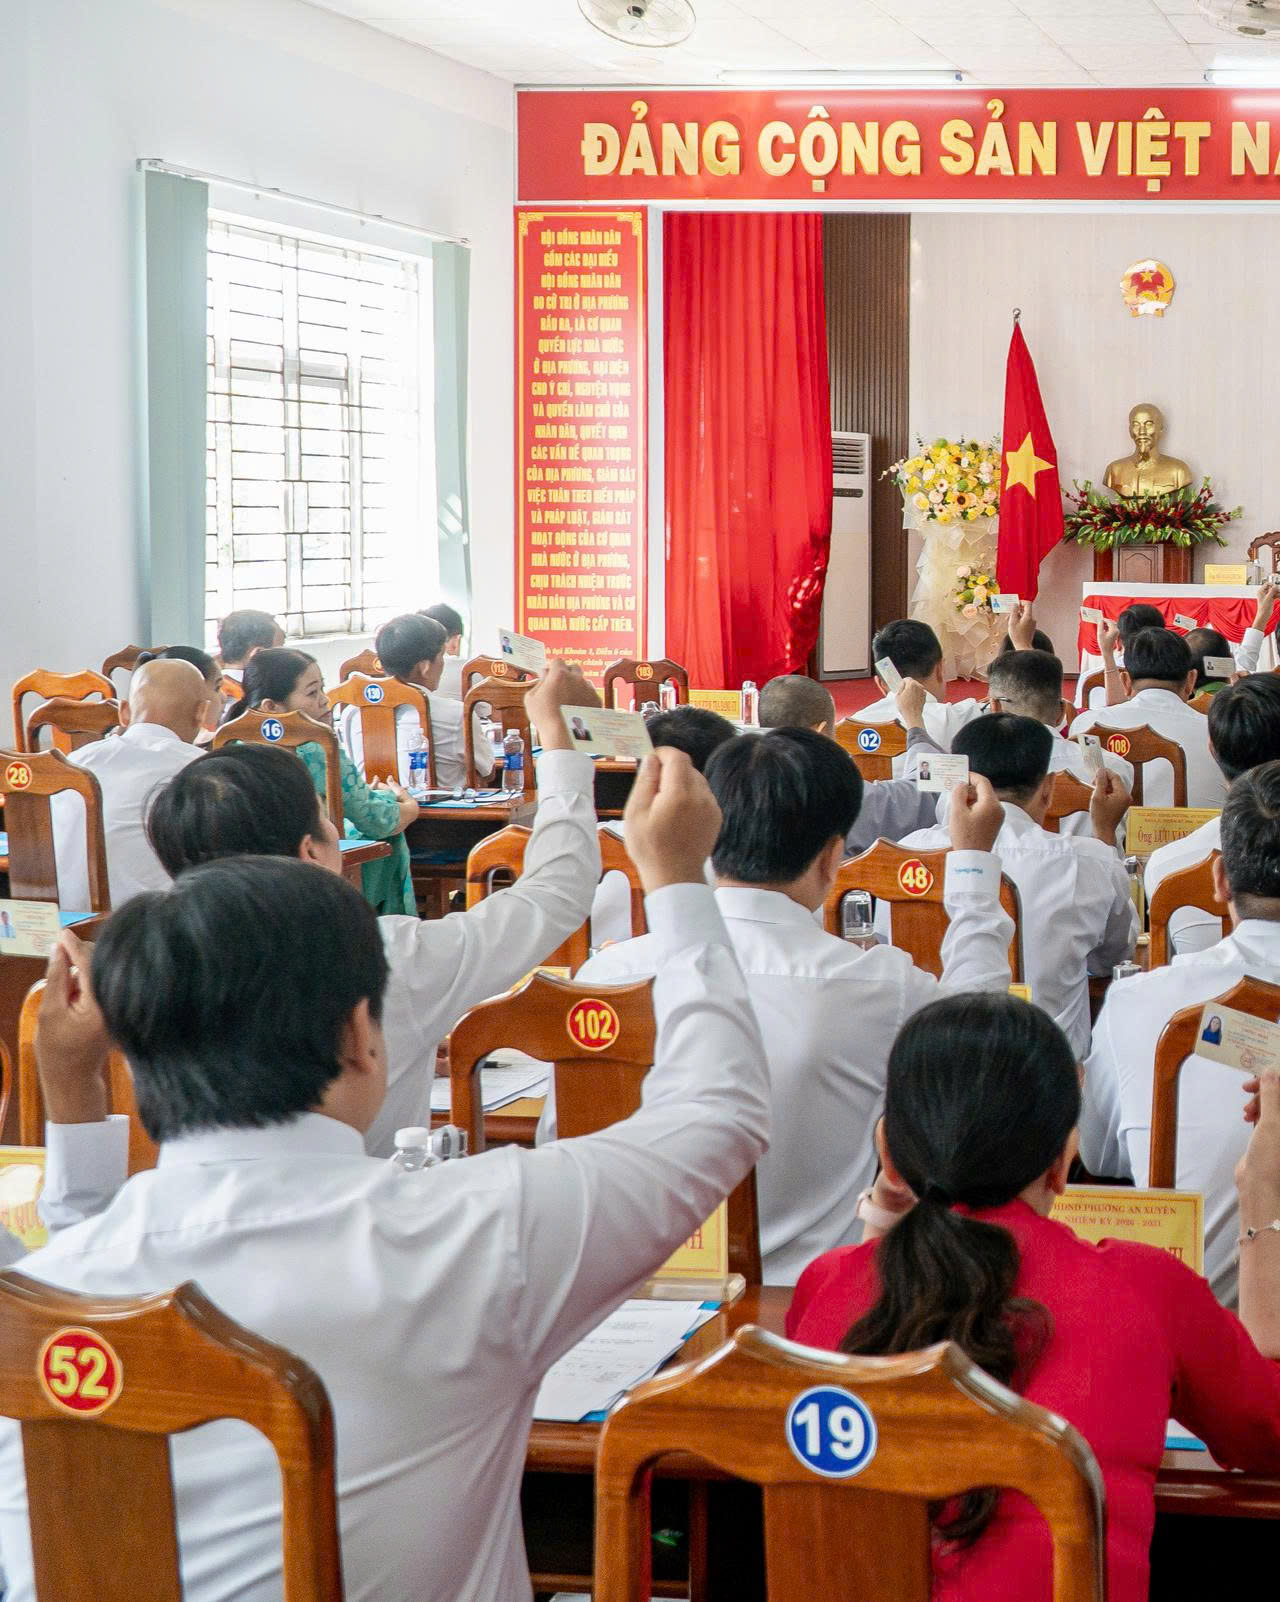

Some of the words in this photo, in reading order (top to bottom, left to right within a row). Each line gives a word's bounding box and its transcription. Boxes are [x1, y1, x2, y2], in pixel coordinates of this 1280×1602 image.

[581, 100, 740, 175] ĐẢNG
[758, 105, 921, 192] CỘNG
[940, 99, 1058, 175] SẢN
[1076, 108, 1210, 191] VIỆT
[263, 723, 282, 737] 16
[861, 732, 878, 747] 02
[1110, 738, 1127, 754] 108
[8, 767, 27, 785] 28
[902, 866, 928, 889] 48
[574, 1009, 613, 1041] 102
[1142, 1204, 1177, 1216] XUYÊN
[48, 1347, 110, 1398] 52
[795, 1402, 863, 1460] 19
